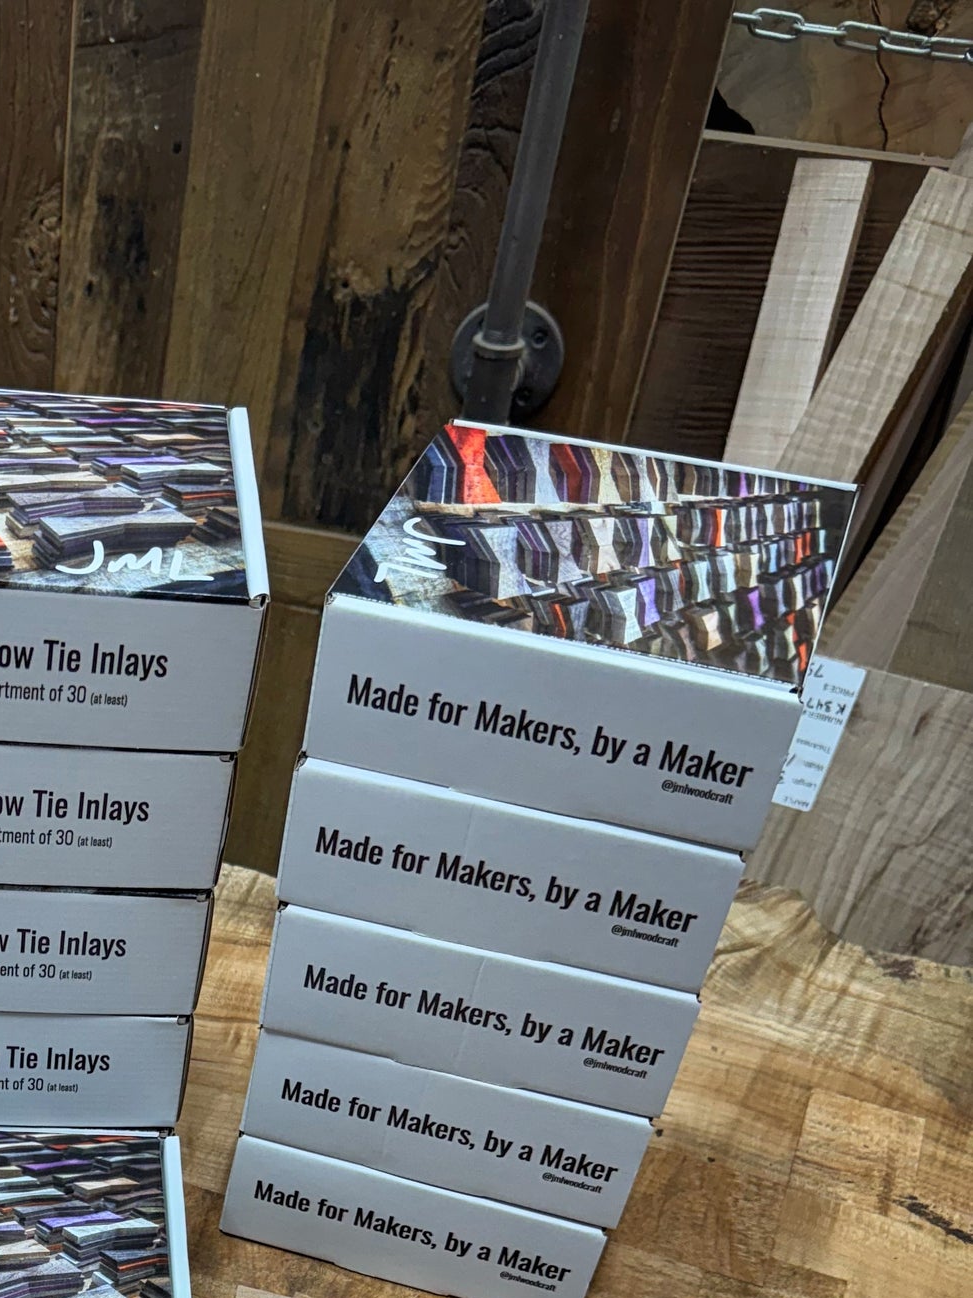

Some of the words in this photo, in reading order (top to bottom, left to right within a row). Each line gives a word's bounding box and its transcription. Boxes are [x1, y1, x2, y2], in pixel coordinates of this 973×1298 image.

[44, 640, 80, 672] Tie
[91, 643, 168, 681] Inlays
[49, 685, 63, 702] of
[67, 685, 86, 703] 30
[91, 693, 102, 705] (at
[104, 694, 127, 707] least)
[347, 674, 418, 716] Made
[428, 693, 468, 726] for
[474, 701, 580, 755] Makers,
[591, 726, 627, 763] by
[633, 744, 650, 766] a
[659, 741, 754, 787] Maker
[33, 790, 67, 818] Tie
[78, 792, 149, 825] Inlays
[662, 780, 733, 804] @jmlwoodcraft
[39, 830, 52, 844] of
[56, 830, 73, 845] 30
[78, 836, 88, 847] (at
[91, 837, 112, 848] least)
[316, 827, 383, 865] Made
[392, 844, 430, 874] for
[435, 852, 535, 902] Makers,
[545, 876, 579, 909] by
[584, 892, 601, 912] a
[609, 890, 698, 932] Maker
[17, 929, 50, 954] Tie
[59, 931, 126, 960] Inlays
[23, 964, 35, 977] of
[39, 964, 55, 978] 30
[59, 970, 69, 980] (at
[72, 970, 92, 981] least)
[304, 965, 367, 1000] Made
[376, 982, 411, 1009] for
[417, 990, 511, 1036] Makers,
[521, 1013, 552, 1043] by
[558, 1028, 573, 1046] a
[581, 1027, 665, 1065] Maker
[6, 1046, 37, 1069] Tie
[47, 1048, 110, 1074] Inlays
[13, 1078, 24, 1090] of
[28, 1078, 43, 1091] 30
[47, 1083, 57, 1092] (at
[59, 1084, 78, 1093] least)
[282, 1079, 340, 1112] Made
[349, 1097, 381, 1121] for
[387, 1106, 474, 1150] Makers,
[483, 1130, 513, 1158] by
[518, 1145, 533, 1161] a
[540, 1145, 618, 1182] Maker
[254, 1180, 310, 1212] Made
[318, 1199, 348, 1221] for
[354, 1208, 436, 1249] Makers,
[444, 1232, 472, 1257] by
[477, 1247, 491, 1261] a
[497, 1247, 571, 1281] Maker
